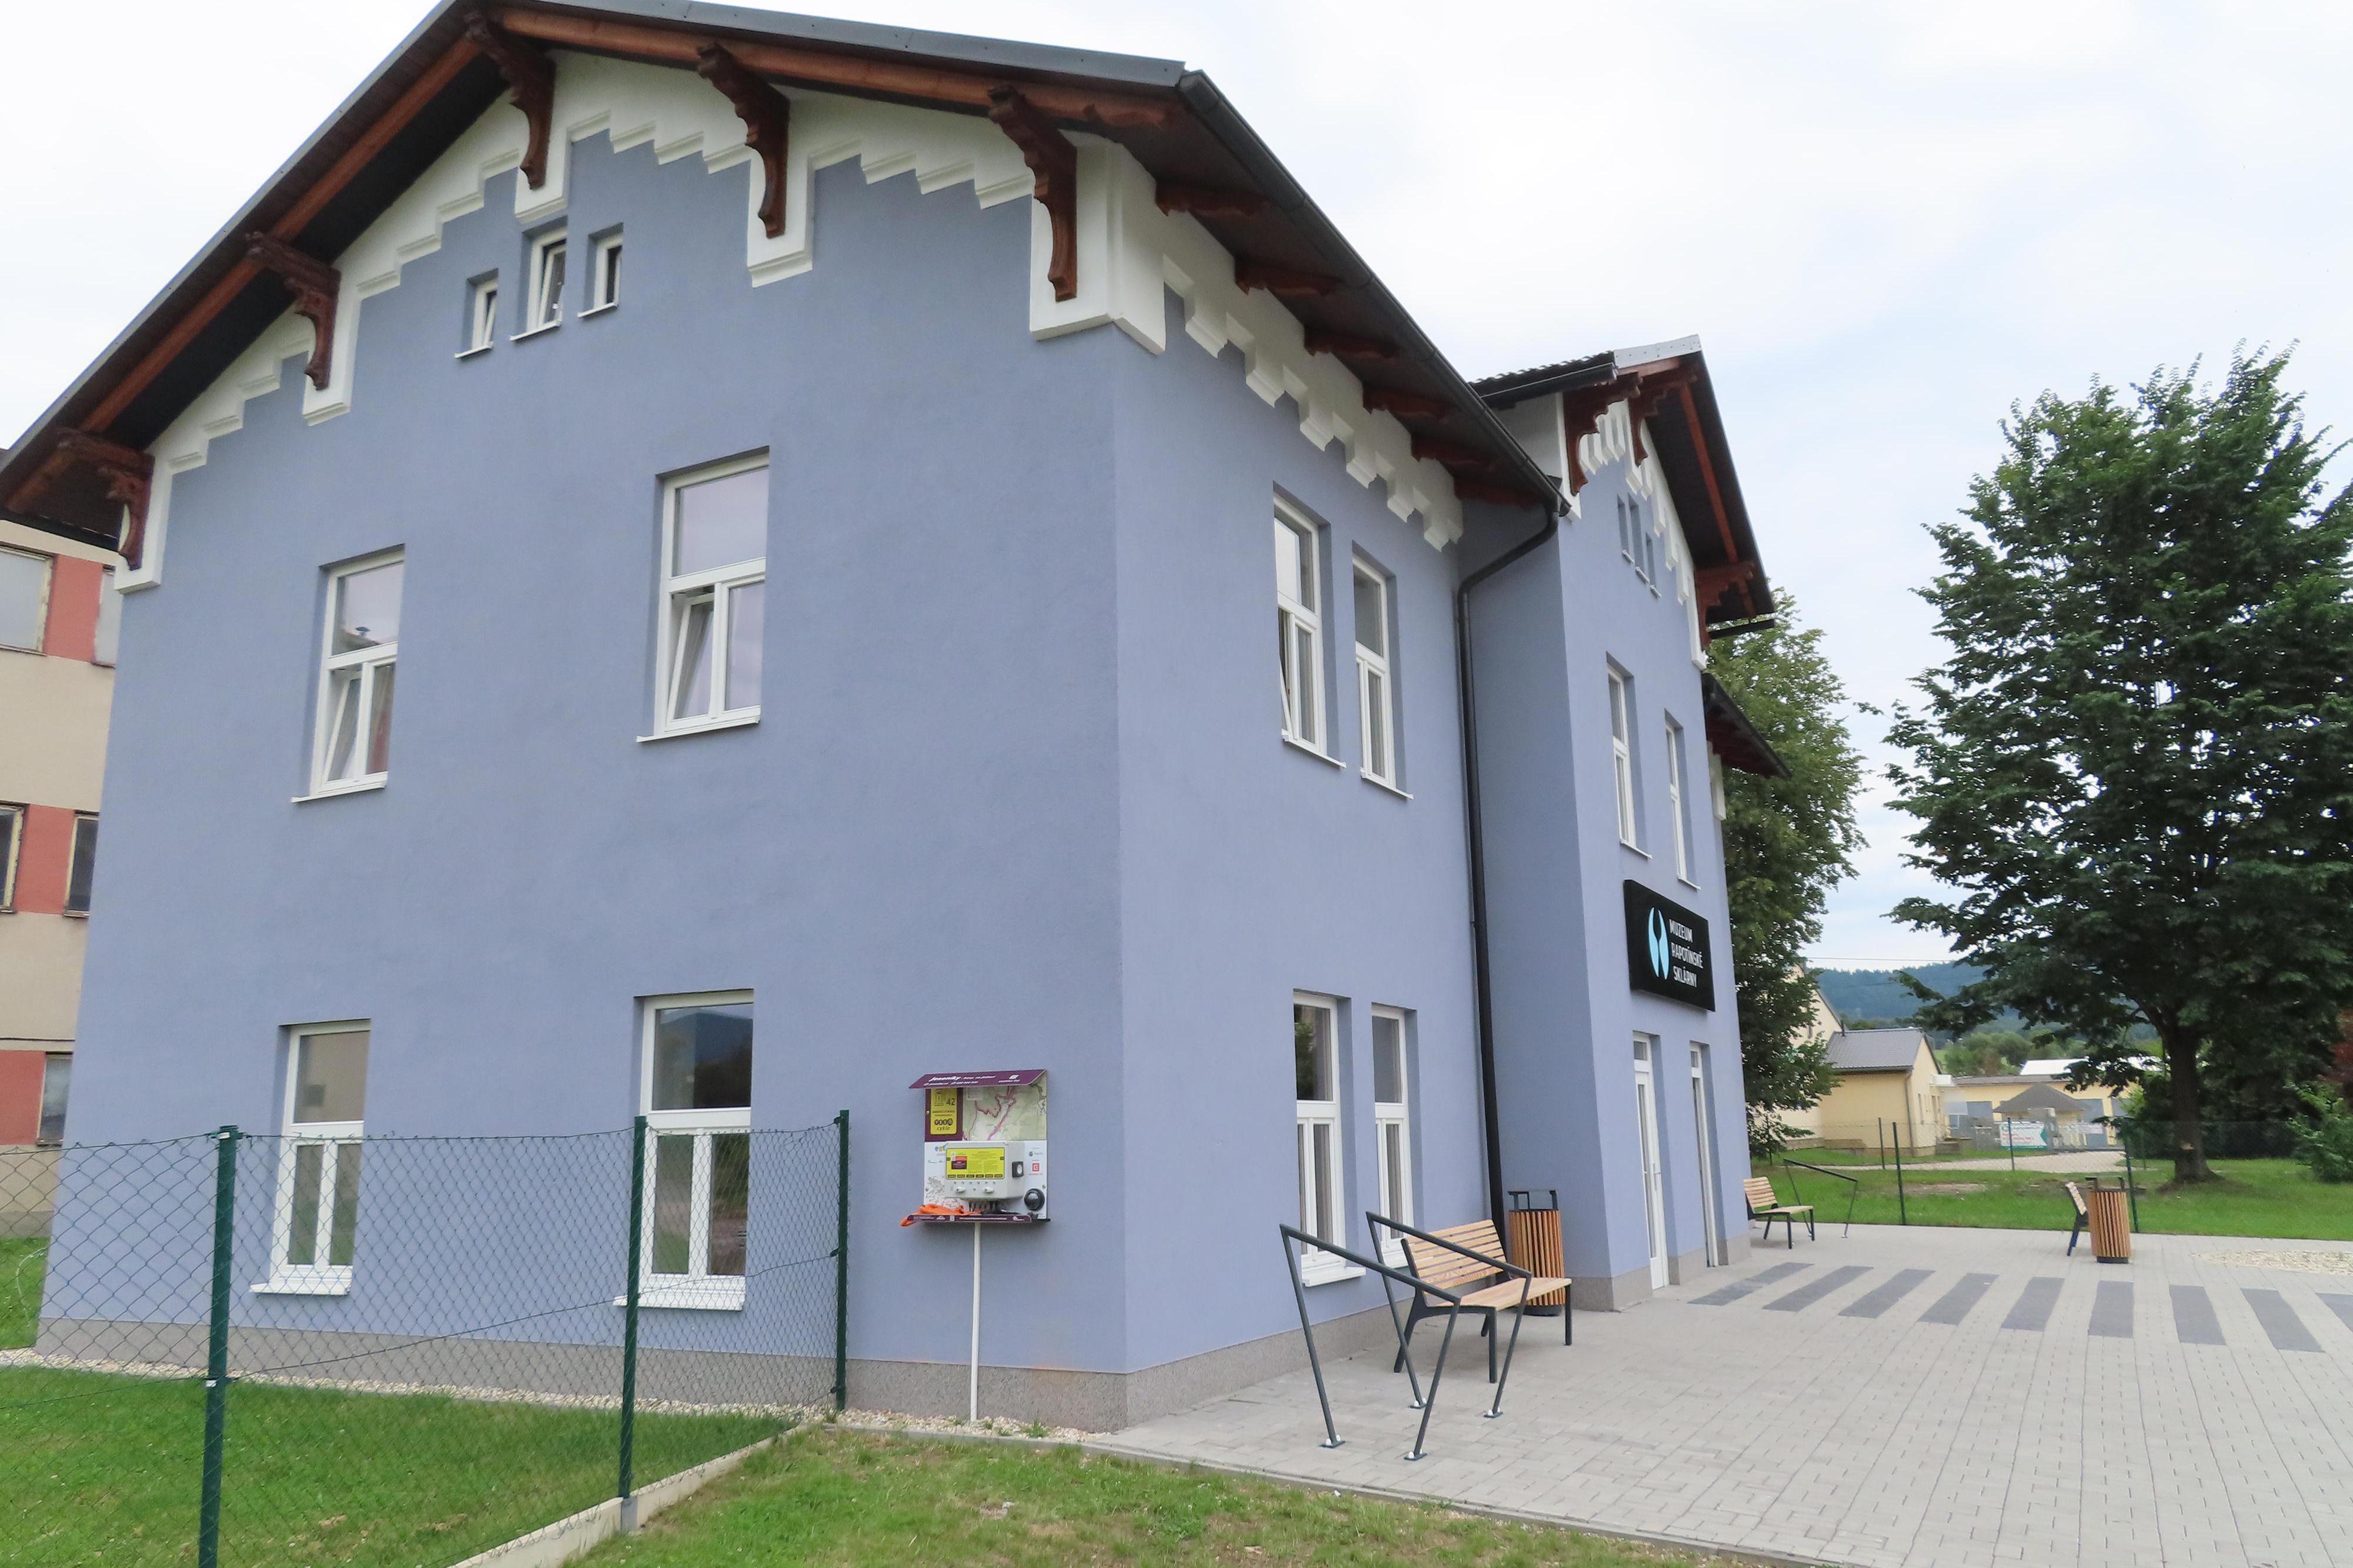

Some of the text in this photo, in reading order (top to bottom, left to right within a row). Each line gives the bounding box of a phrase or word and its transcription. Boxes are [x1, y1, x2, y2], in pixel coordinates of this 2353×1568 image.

[1669, 919, 1693, 943] MUZEUM
[1671, 942, 1704, 969] RAPOTÍNSKÉ
[1673, 965, 1697, 987] SKLÁRNY
